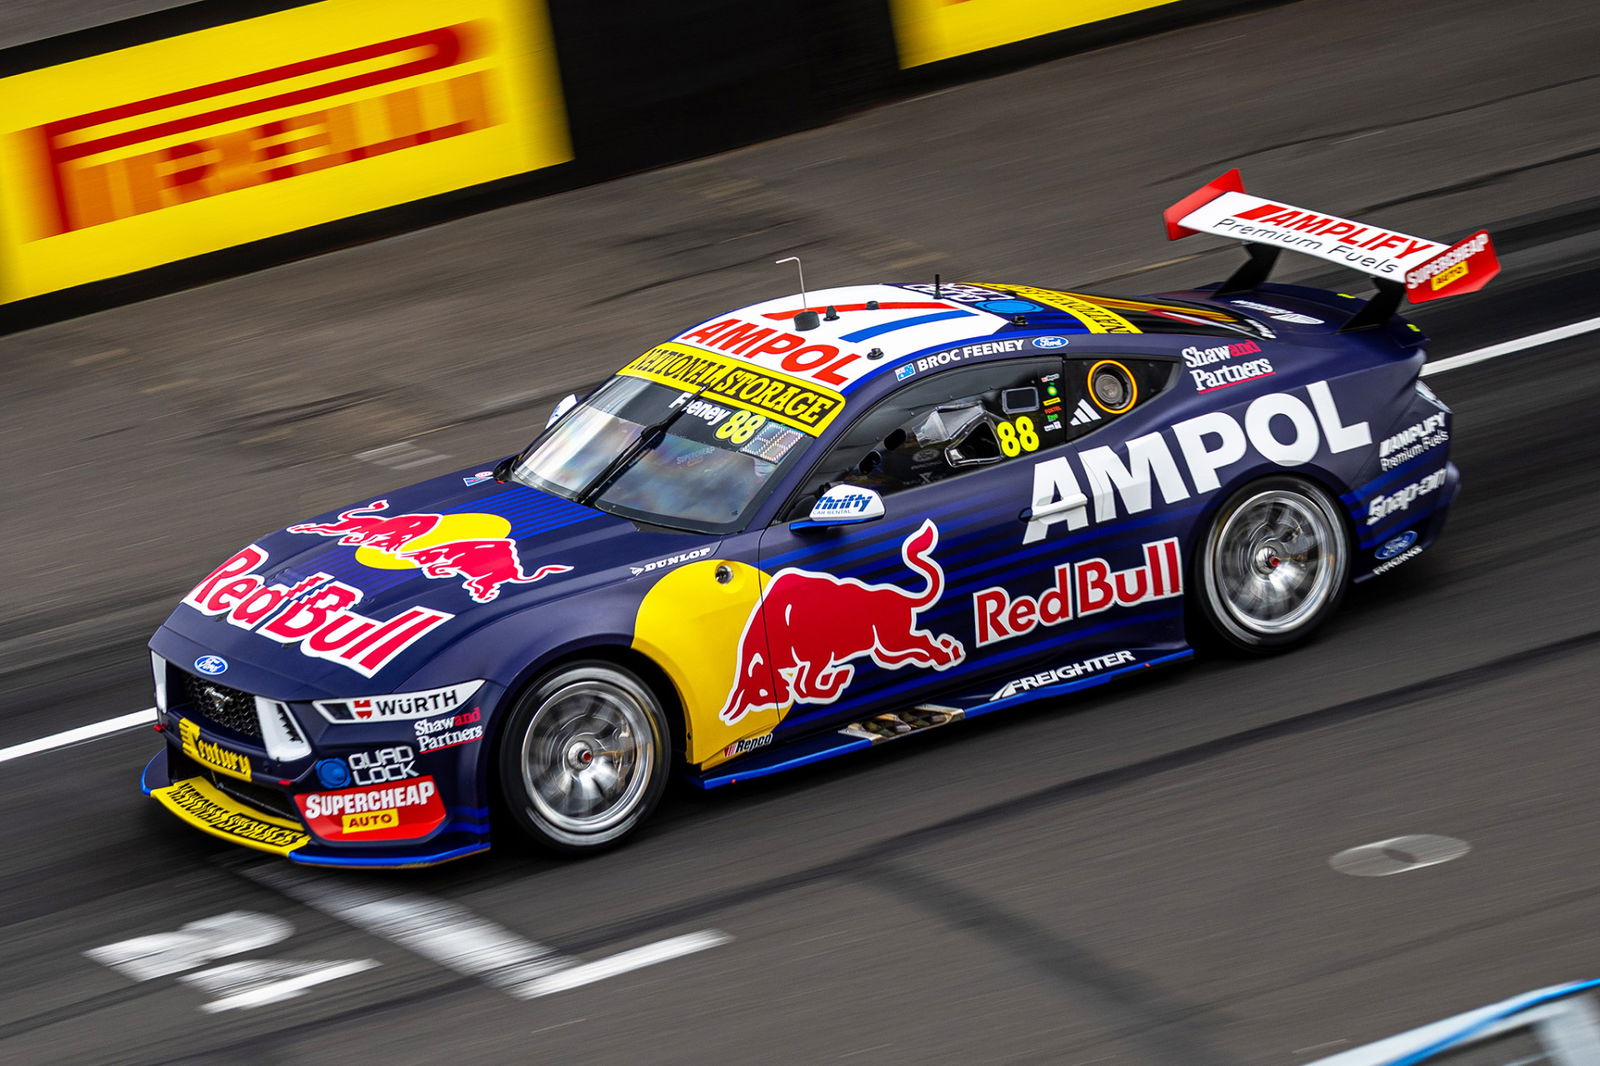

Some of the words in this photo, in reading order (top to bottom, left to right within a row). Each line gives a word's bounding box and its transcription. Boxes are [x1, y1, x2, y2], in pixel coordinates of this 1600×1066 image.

[1213, 218, 1323, 250] Premium
[1327, 245, 1400, 274] Fuels
[1257, 210, 1434, 259] AMPLIFY
[682, 318, 862, 386] AMPOL
[916, 349, 961, 372] BROC
[963, 339, 1025, 359] FEENEY
[630, 349, 722, 387] NATIONAL
[715, 369, 834, 424] STORAGE
[1189, 358, 1274, 391] Partners
[668, 392, 732, 426] Feney
[714, 409, 767, 445] 88
[996, 416, 1040, 458] 88
[1021, 380, 1373, 545] AMPOL
[815, 494, 873, 512] Thrifty
[644, 547, 711, 572] DUNLOP
[186, 546, 330, 628] Red
[259, 582, 451, 675] Bull
[975, 565, 1072, 646] Red
[1076, 538, 1183, 616] Bull
[1001, 649, 1137, 697] FREIGHTER
[376, 689, 458, 716] WÜRTH
[348, 745, 414, 770] QUAD
[416, 725, 483, 753] Partners
[352, 760, 420, 786] LOCK
[305, 781, 435, 819] SUPERCHEAP
[349, 813, 393, 828] AUTO
